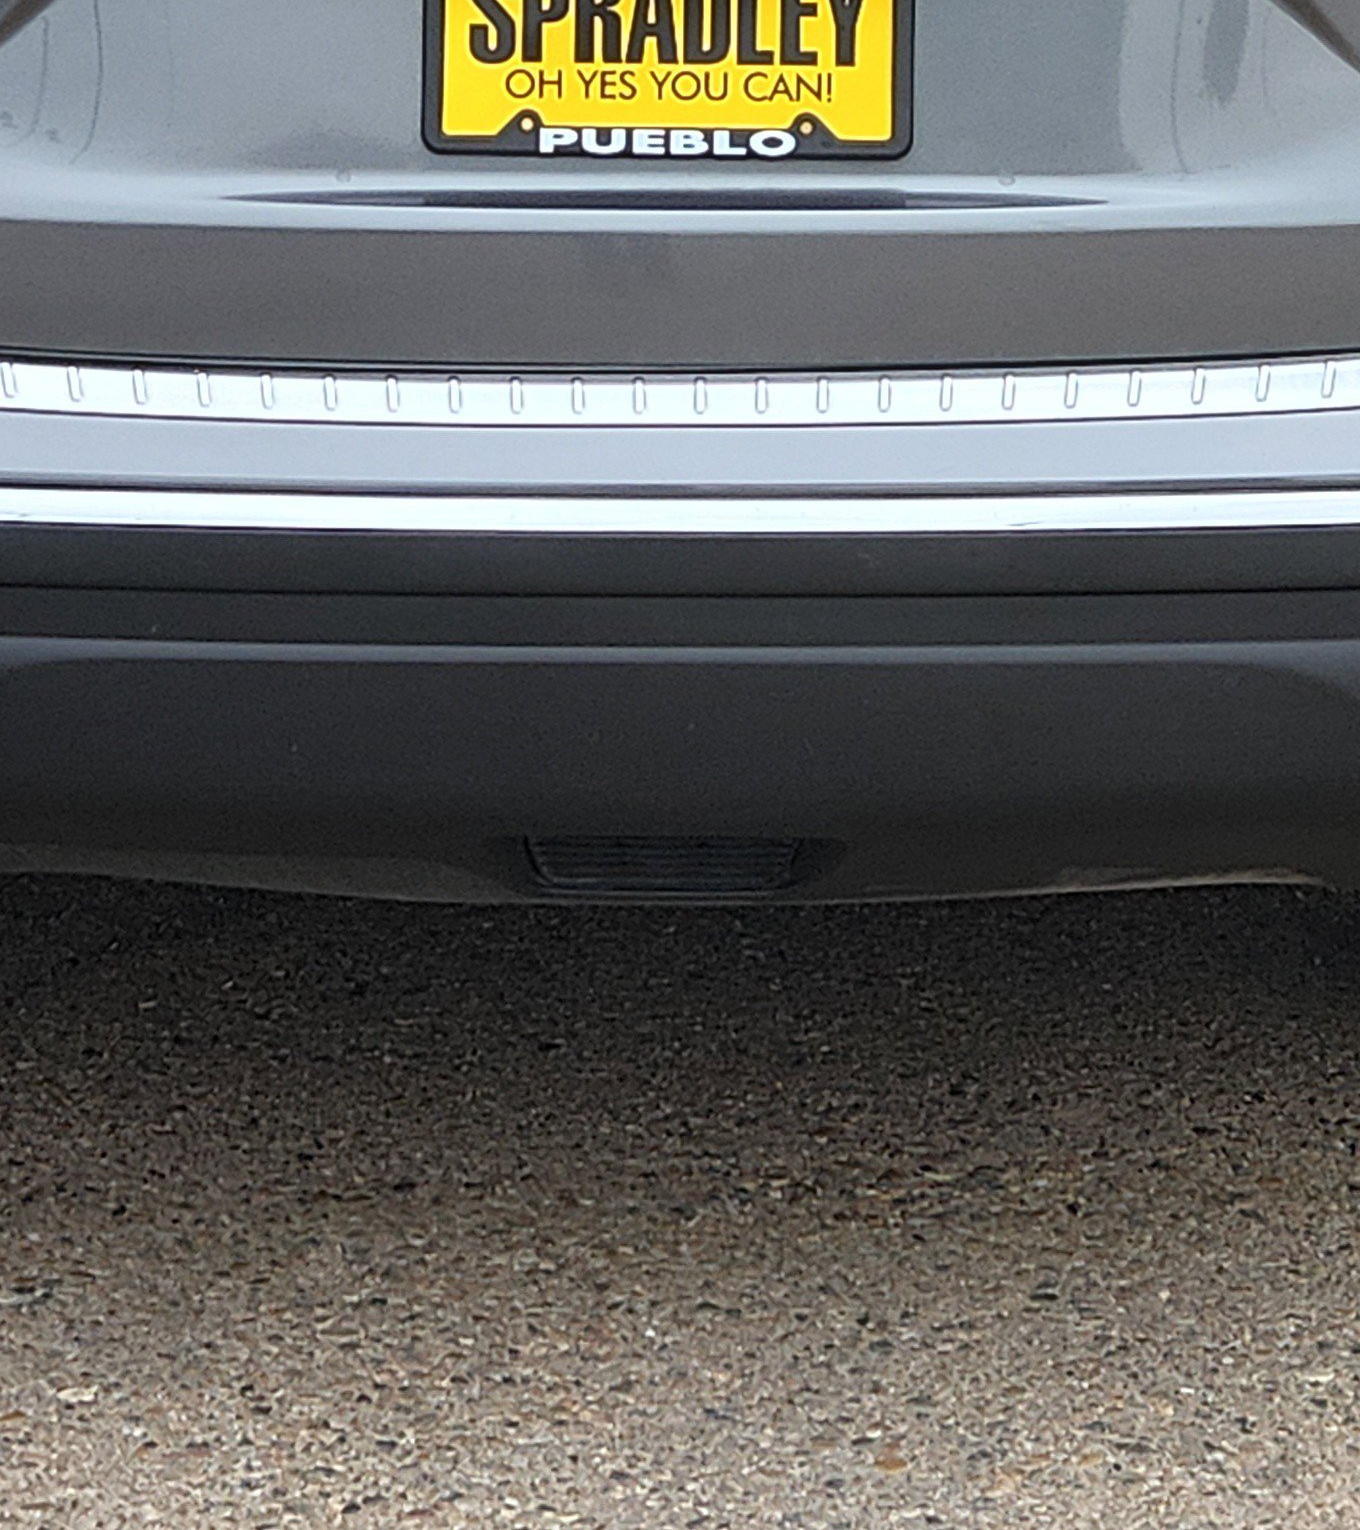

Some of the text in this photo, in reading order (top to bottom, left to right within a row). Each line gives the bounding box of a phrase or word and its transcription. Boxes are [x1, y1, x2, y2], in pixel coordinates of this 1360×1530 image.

[505, 69, 834, 103] OH YES YOU CAN!
[539, 126, 797, 158] PUEBLO
